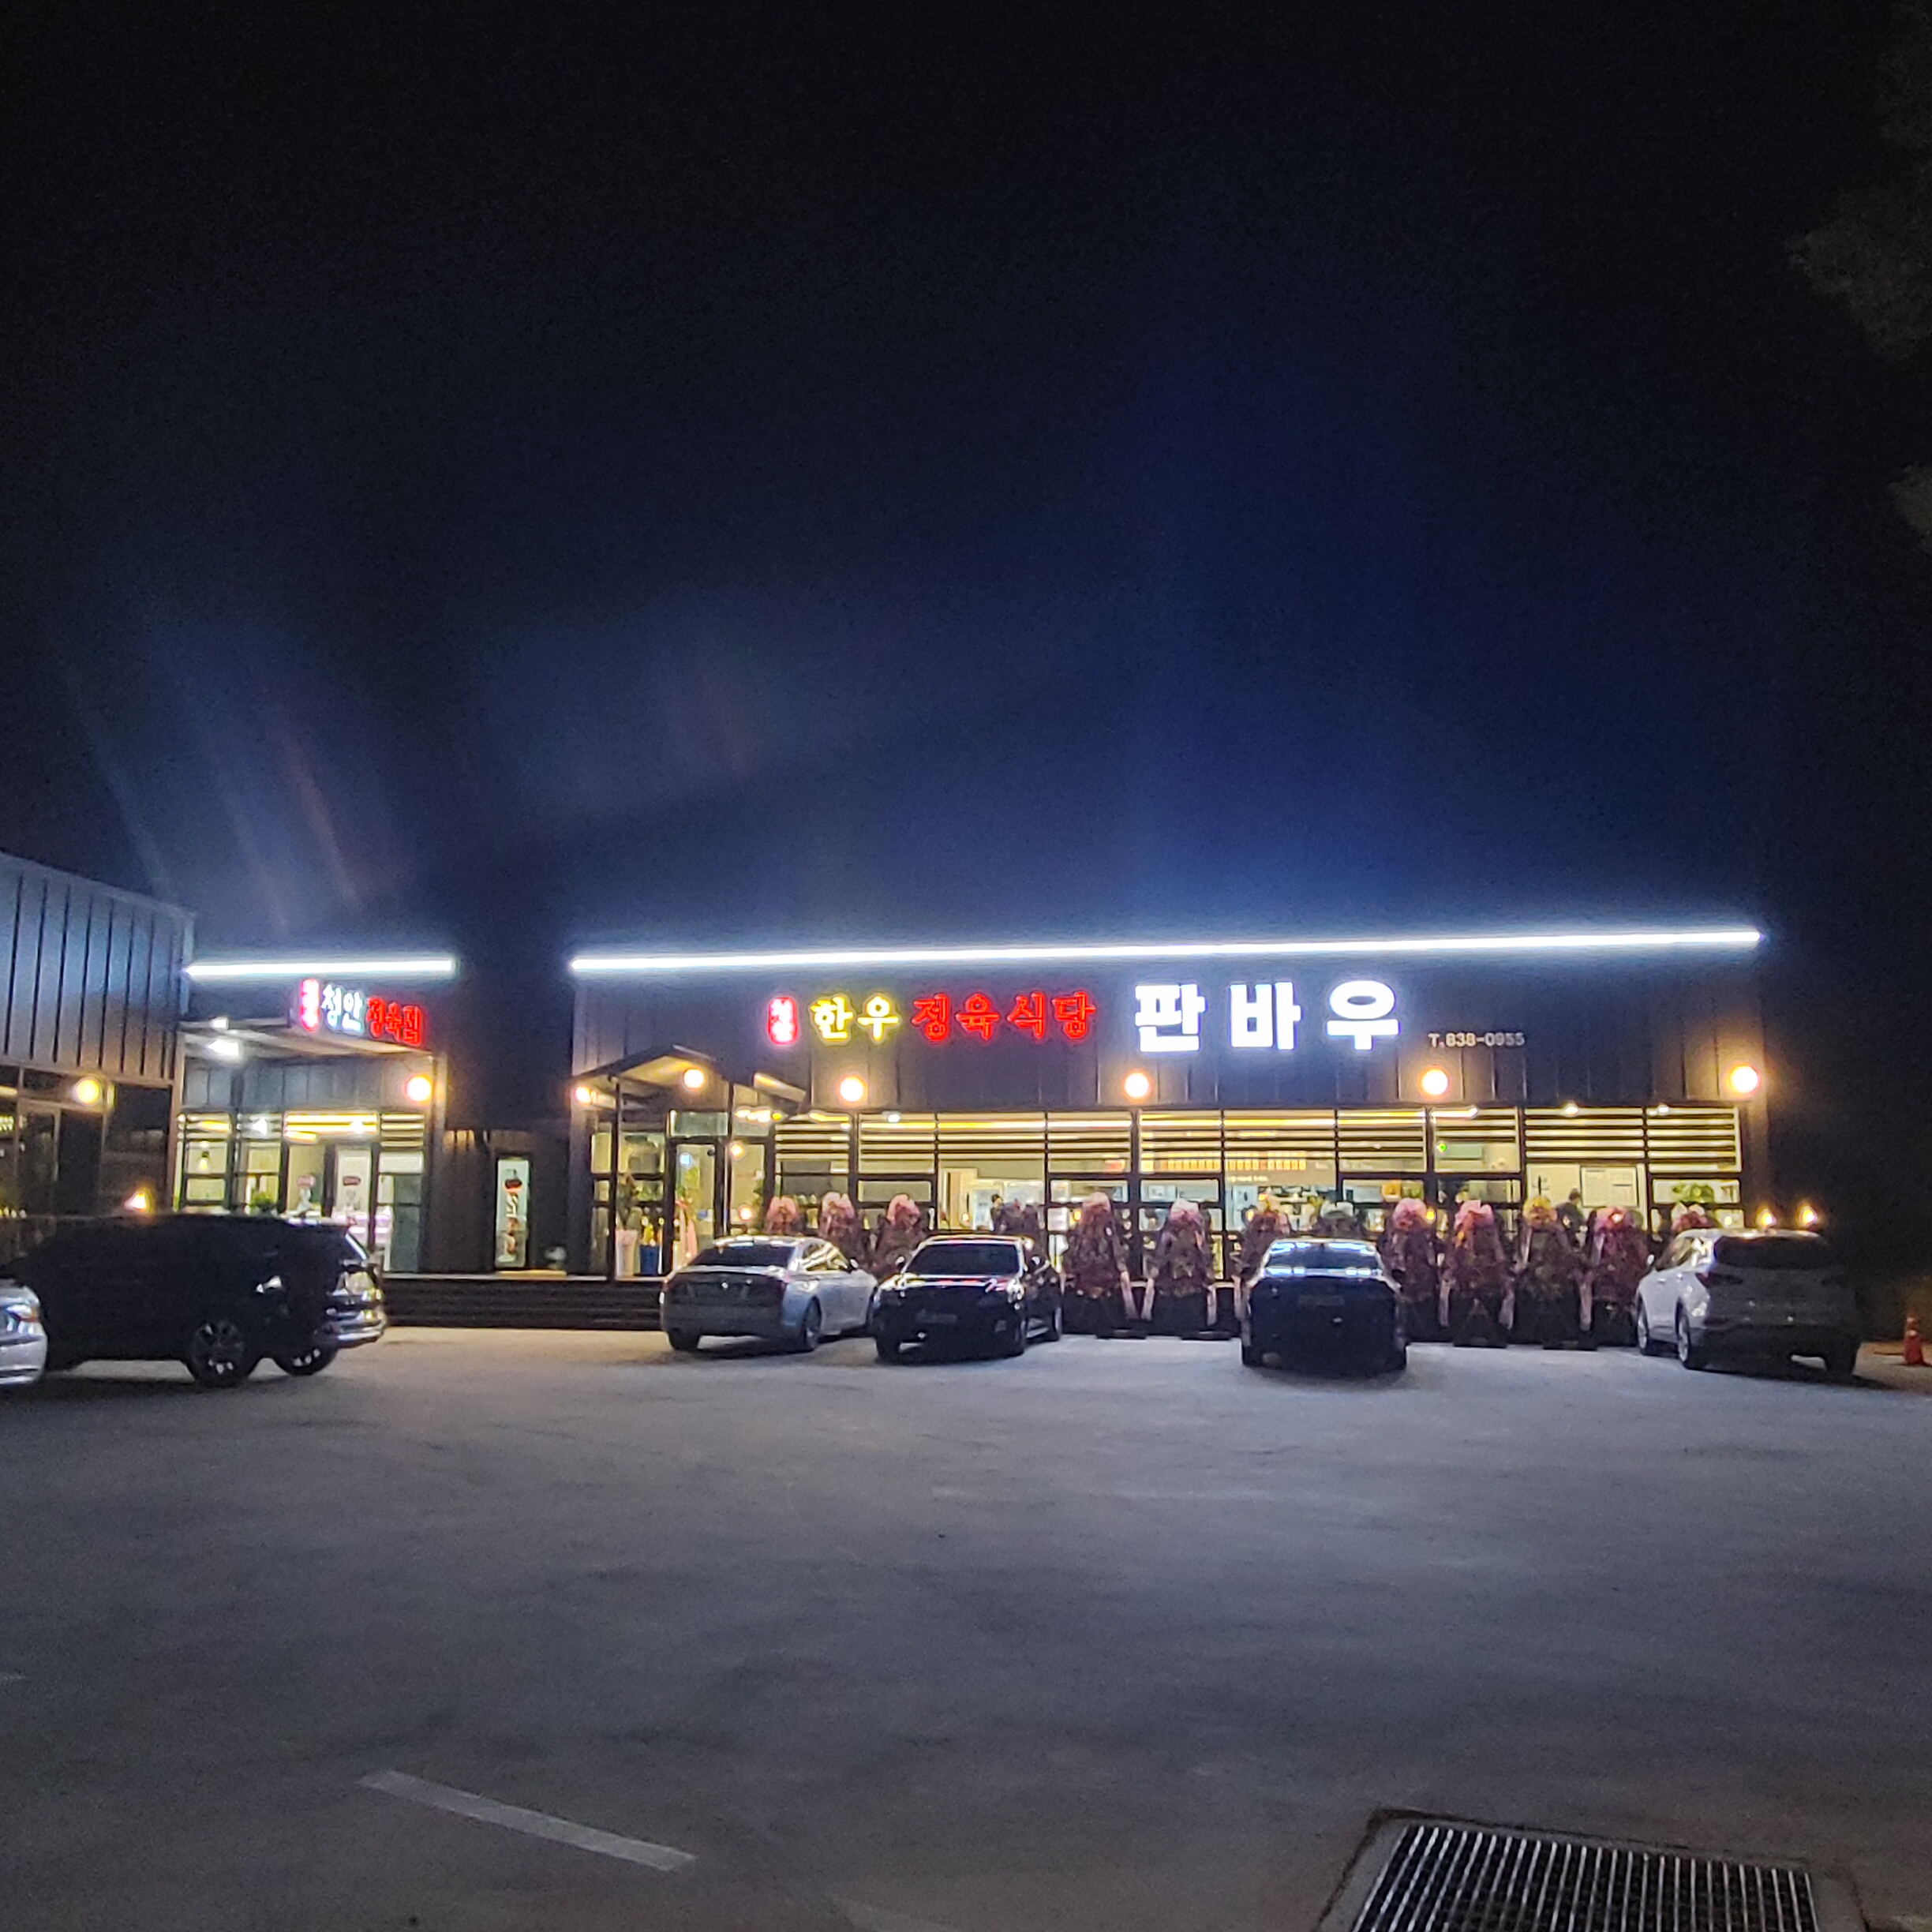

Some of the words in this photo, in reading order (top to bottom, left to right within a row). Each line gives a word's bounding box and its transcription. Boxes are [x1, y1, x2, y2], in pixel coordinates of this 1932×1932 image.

[365, 997, 423, 1046] 정육점
[811, 994, 900, 1041] 한우
[912, 991, 1097, 1042] 정육식당
[1135, 980, 1400, 1053] 판바우
